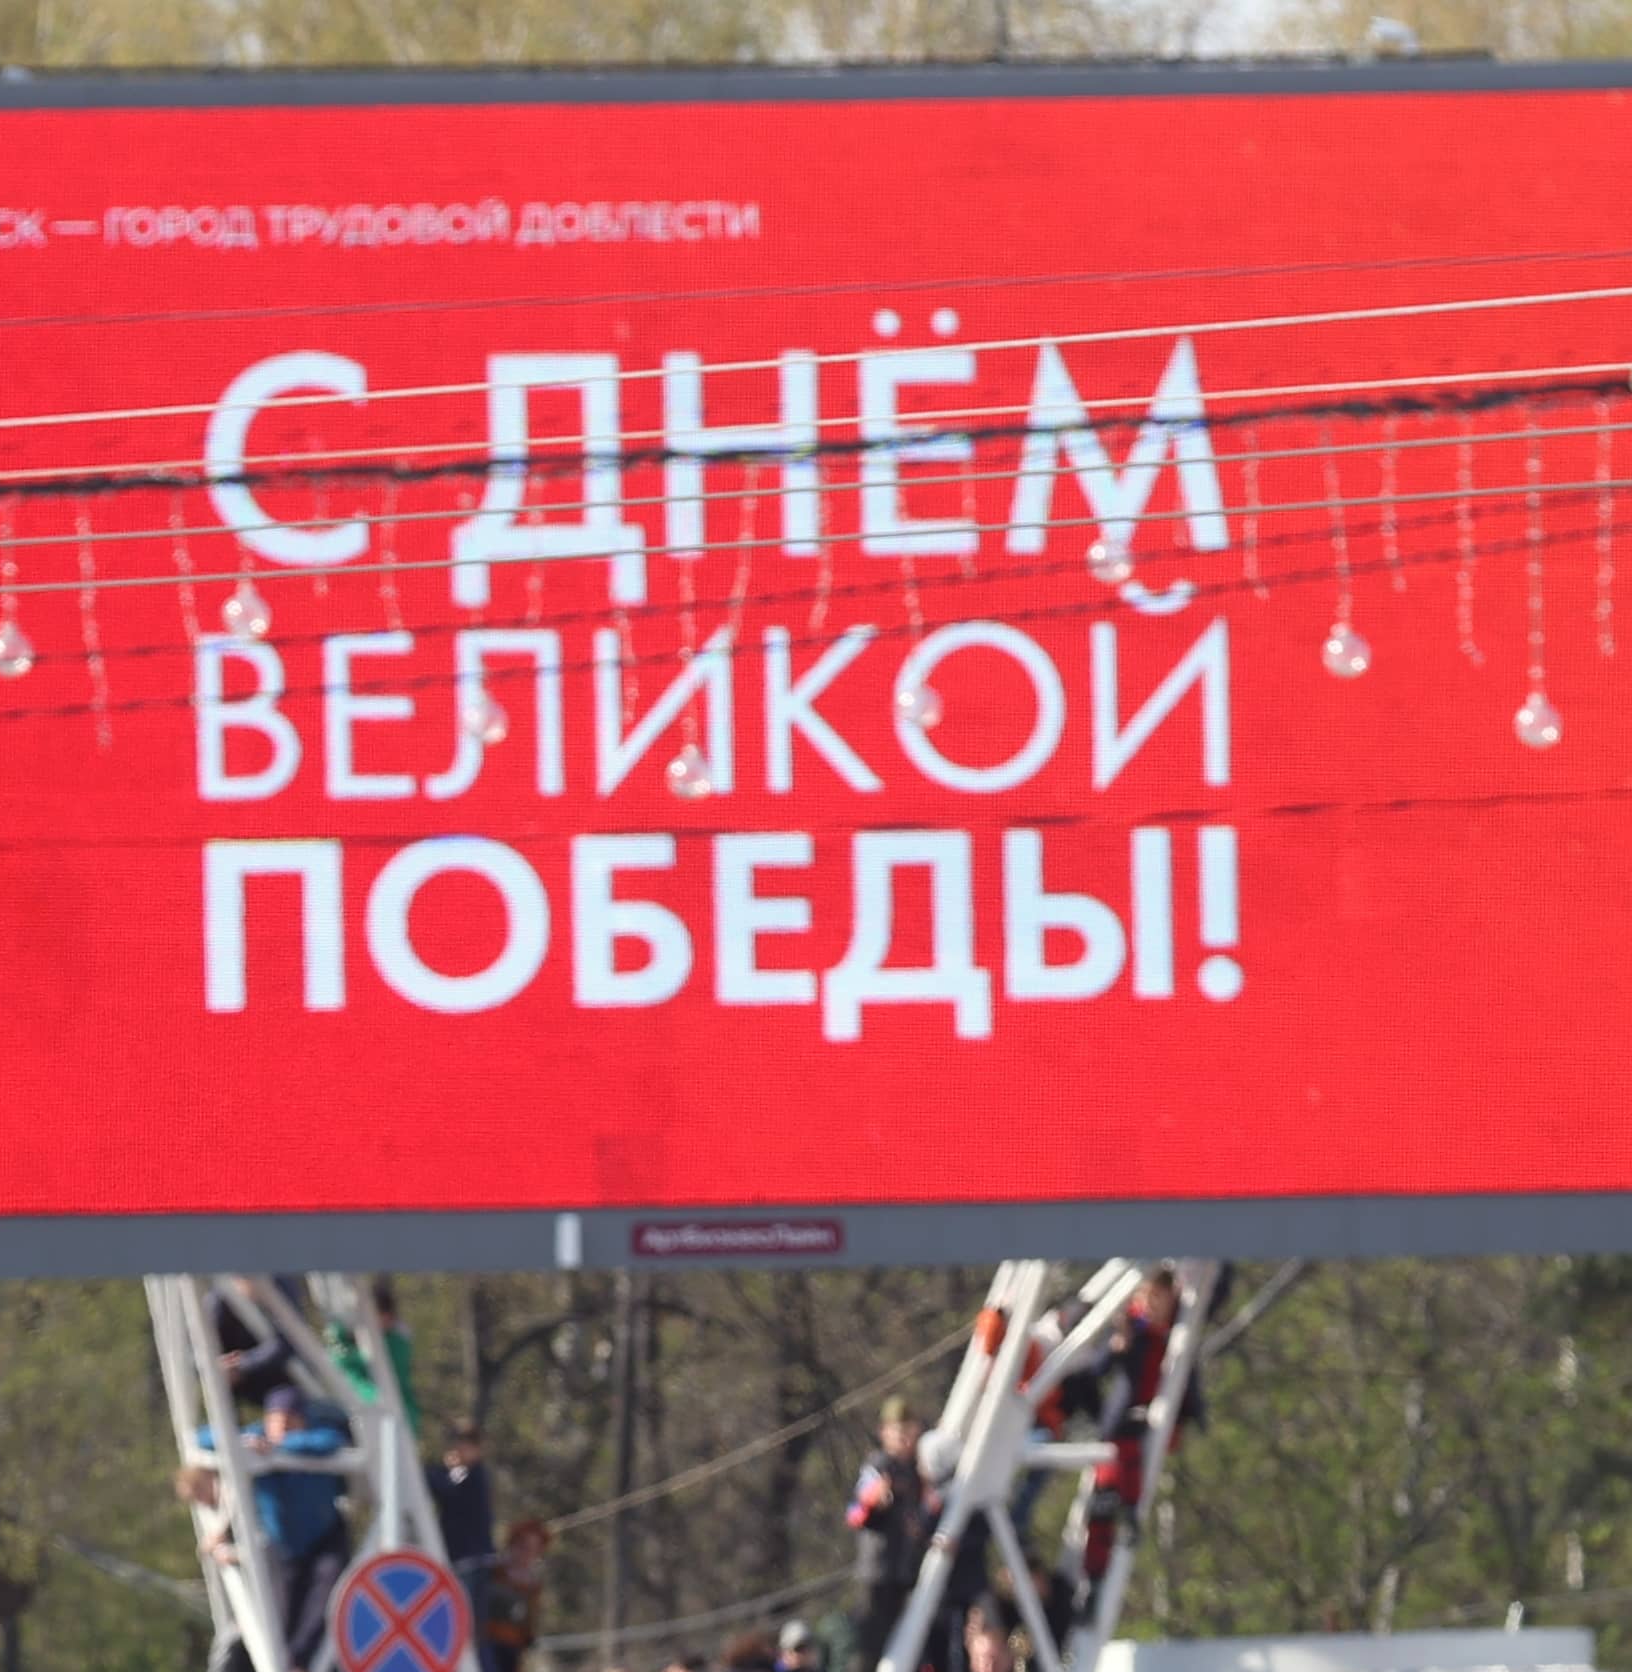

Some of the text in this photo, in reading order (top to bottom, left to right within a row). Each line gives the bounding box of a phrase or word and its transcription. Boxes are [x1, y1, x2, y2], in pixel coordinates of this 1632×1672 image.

[101, 205, 260, 248] ГОРОД
[265, 195, 512, 247] ТРУДОВОЙ
[514, 199, 761, 248] ДОБЛЕСТИ
[204, 308, 1230, 607] С ДНЁМ
[194, 580, 1230, 800] ВЕЛИКОЙ
[203, 826, 1244, 1040] ПОБЕДЫ!
